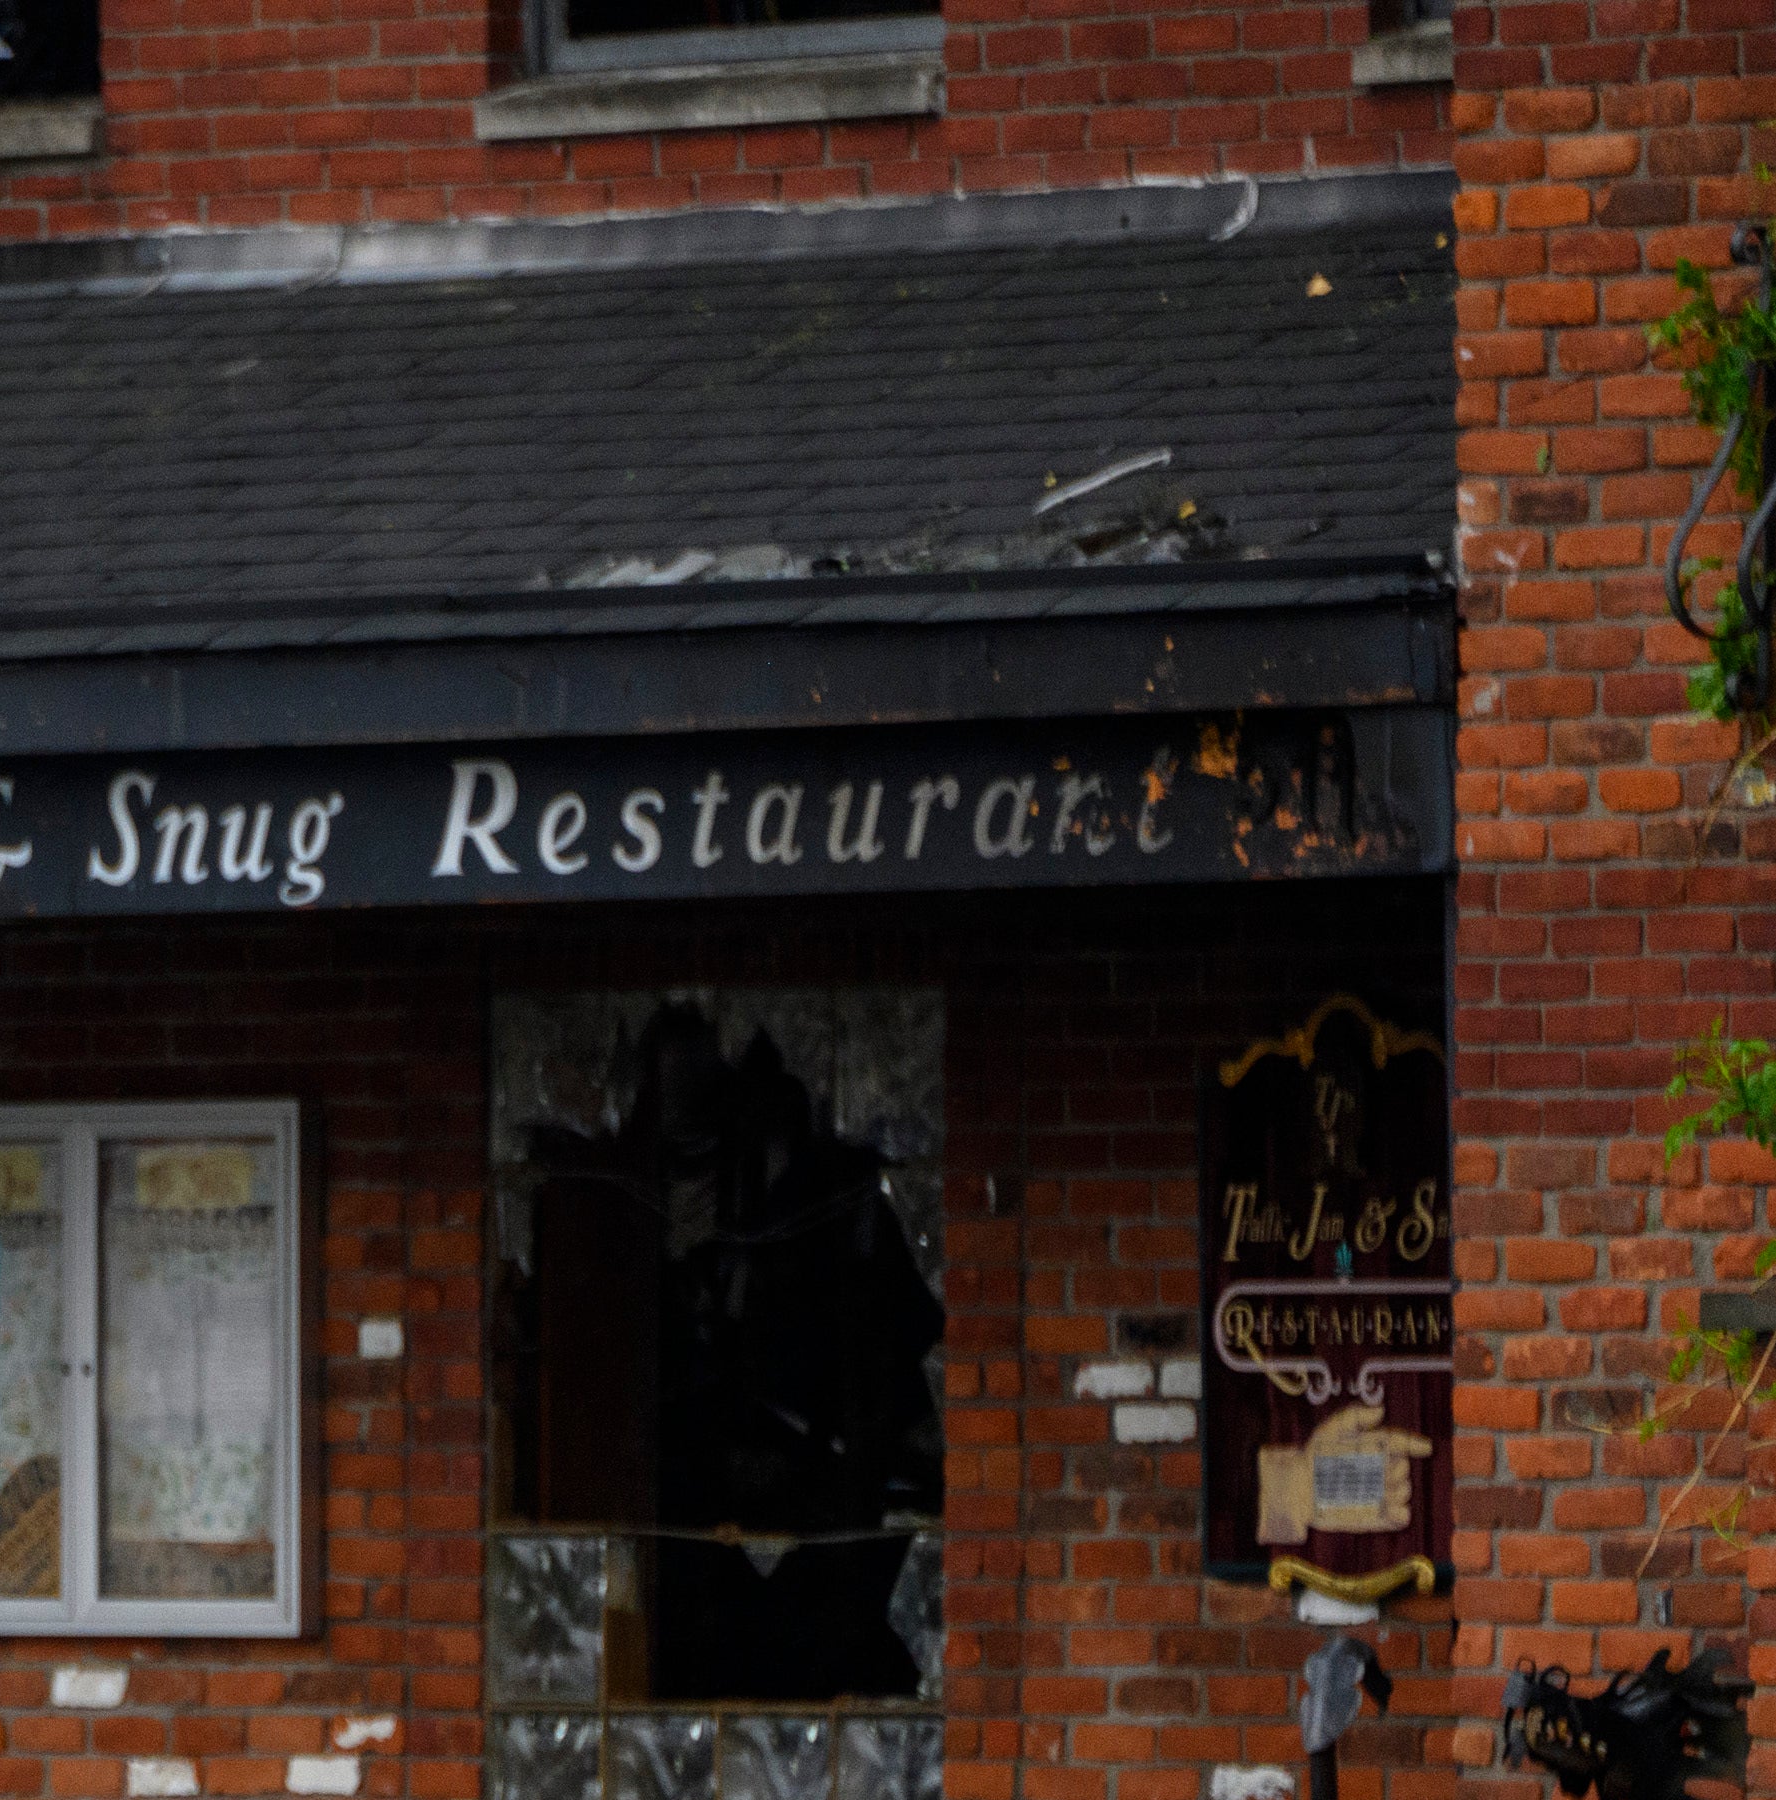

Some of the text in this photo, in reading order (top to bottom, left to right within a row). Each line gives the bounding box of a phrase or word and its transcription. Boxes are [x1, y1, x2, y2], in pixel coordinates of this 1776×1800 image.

[86, 769, 346, 908] Snug
[430, 745, 1176, 877] Restaurant
[1396, 1176, 1449, 1262] Sn
